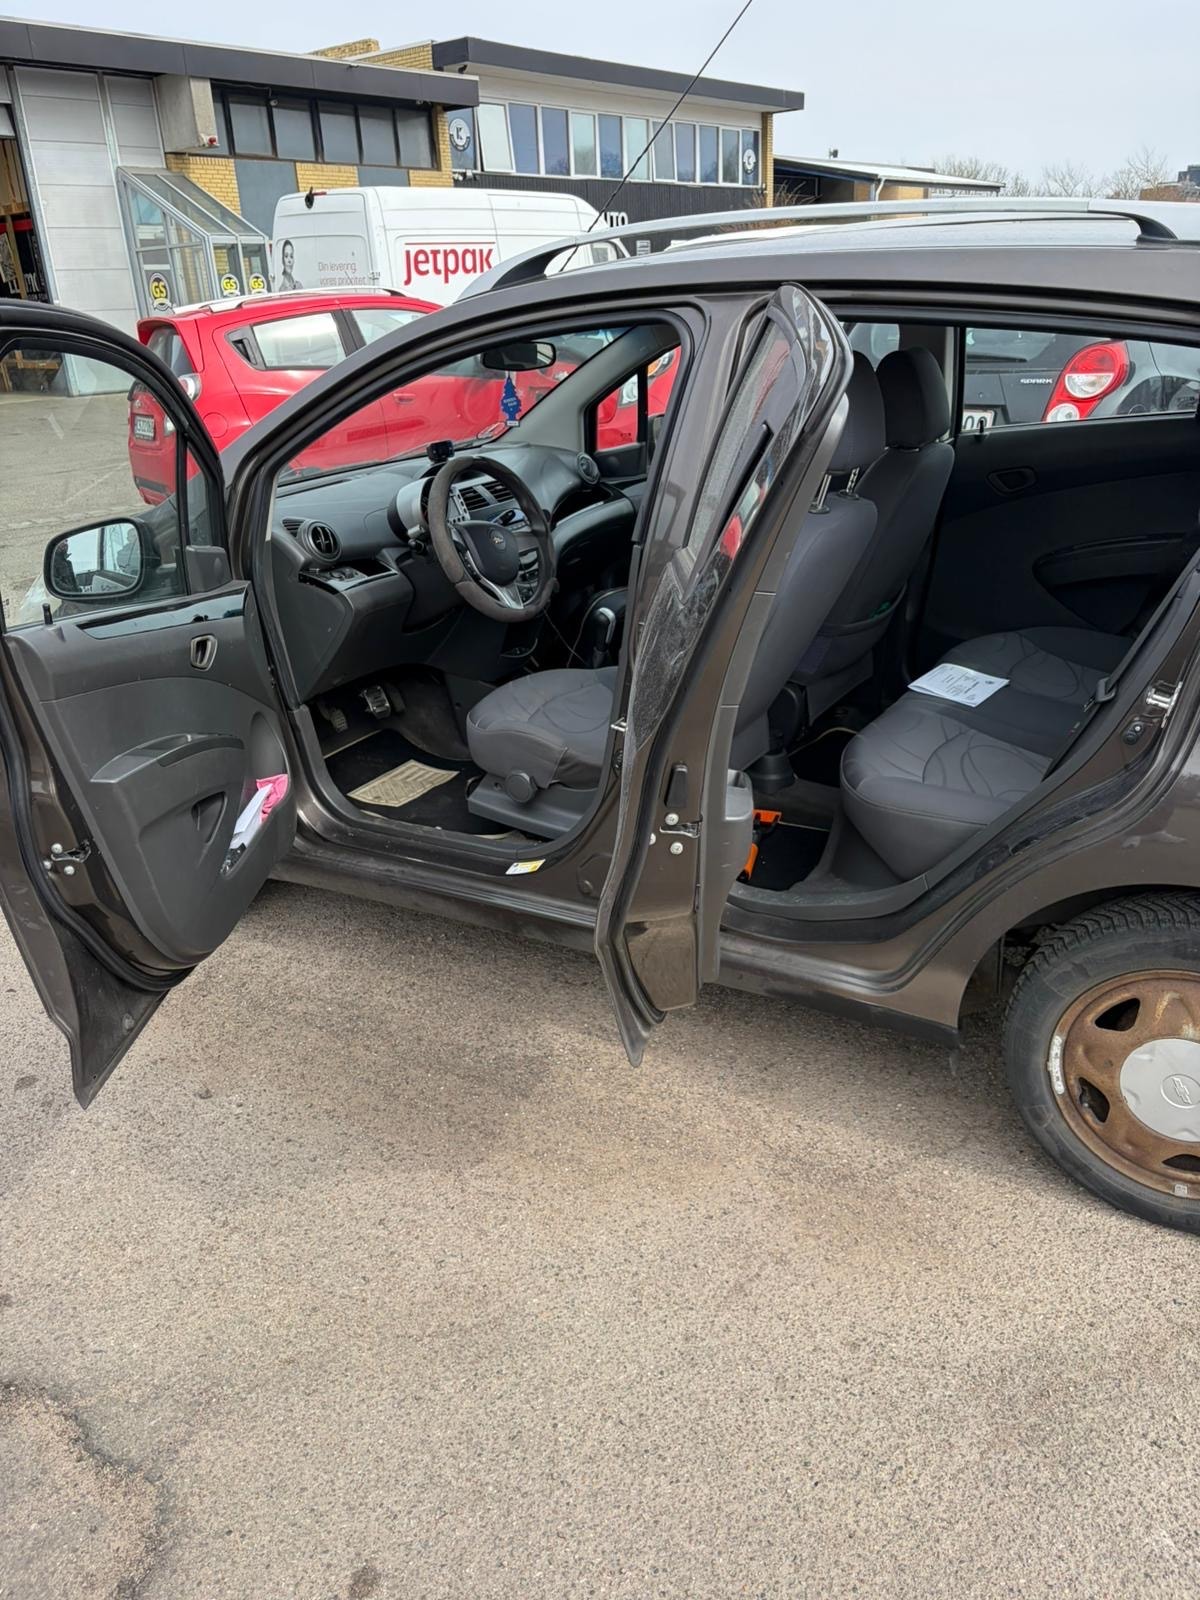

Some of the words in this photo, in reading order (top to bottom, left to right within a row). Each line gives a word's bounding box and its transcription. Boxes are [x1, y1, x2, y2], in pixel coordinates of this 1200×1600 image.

[403, 248, 493, 286] jetpak
[152, 281, 167, 299] GS
[223, 278, 237, 291] GS
[251, 278, 264, 291] GS
